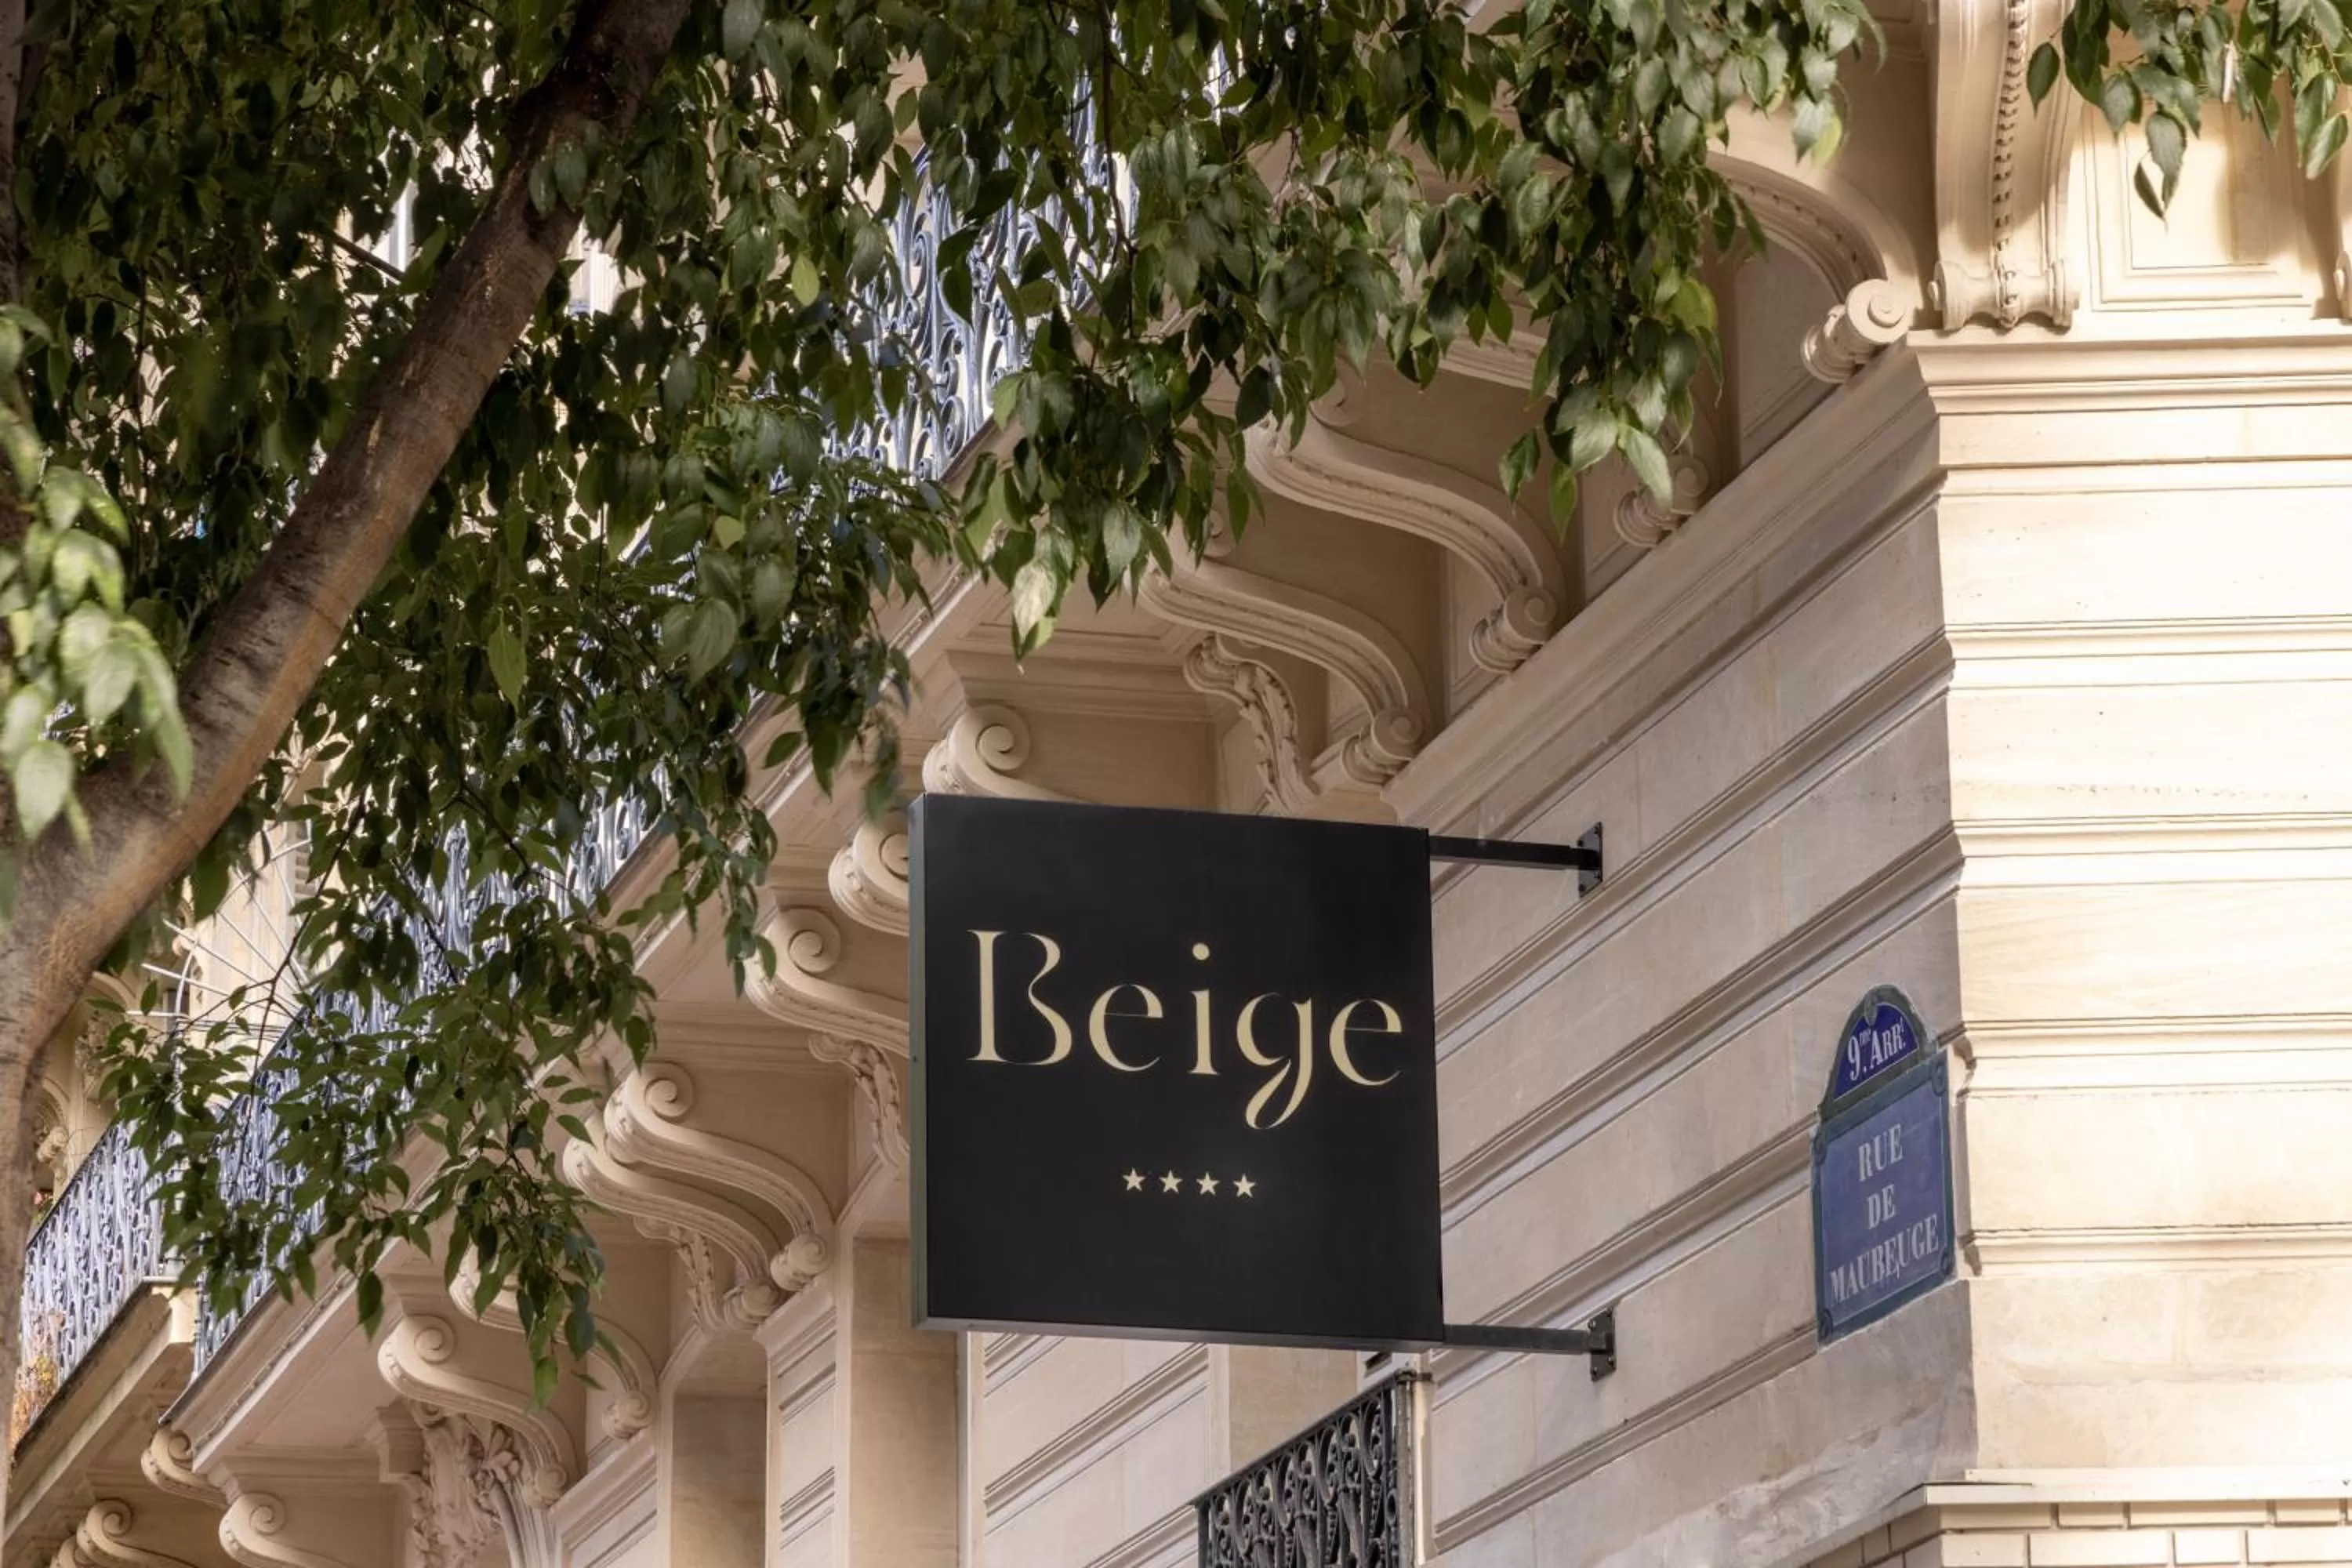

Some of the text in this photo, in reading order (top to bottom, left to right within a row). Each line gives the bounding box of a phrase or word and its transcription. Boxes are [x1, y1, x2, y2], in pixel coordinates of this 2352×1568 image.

[967, 929, 1403, 1130] Beige
[1858, 1123, 1904, 1182] RUE
[1867, 1183, 1896, 1230] DE
[1830, 1213, 1939, 1306] MAUBEUGE
